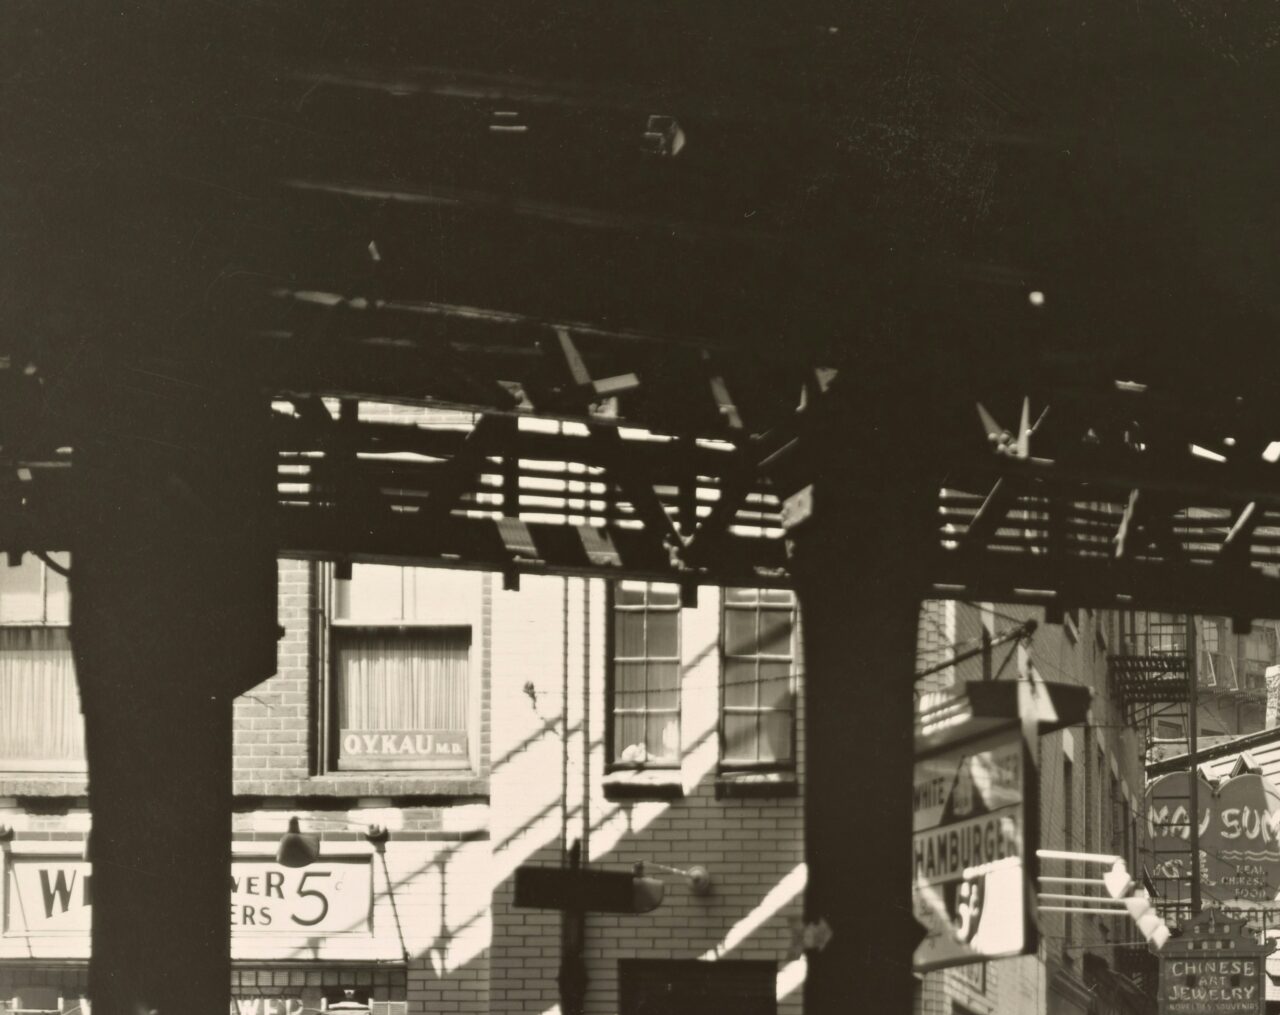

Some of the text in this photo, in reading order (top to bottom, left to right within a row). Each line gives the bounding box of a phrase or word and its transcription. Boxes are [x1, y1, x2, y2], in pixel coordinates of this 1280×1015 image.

[1171, 961, 1255, 976] CHINESE
[1199, 976, 1226, 986] ART
[1168, 985, 1256, 1001] JEWELRY
